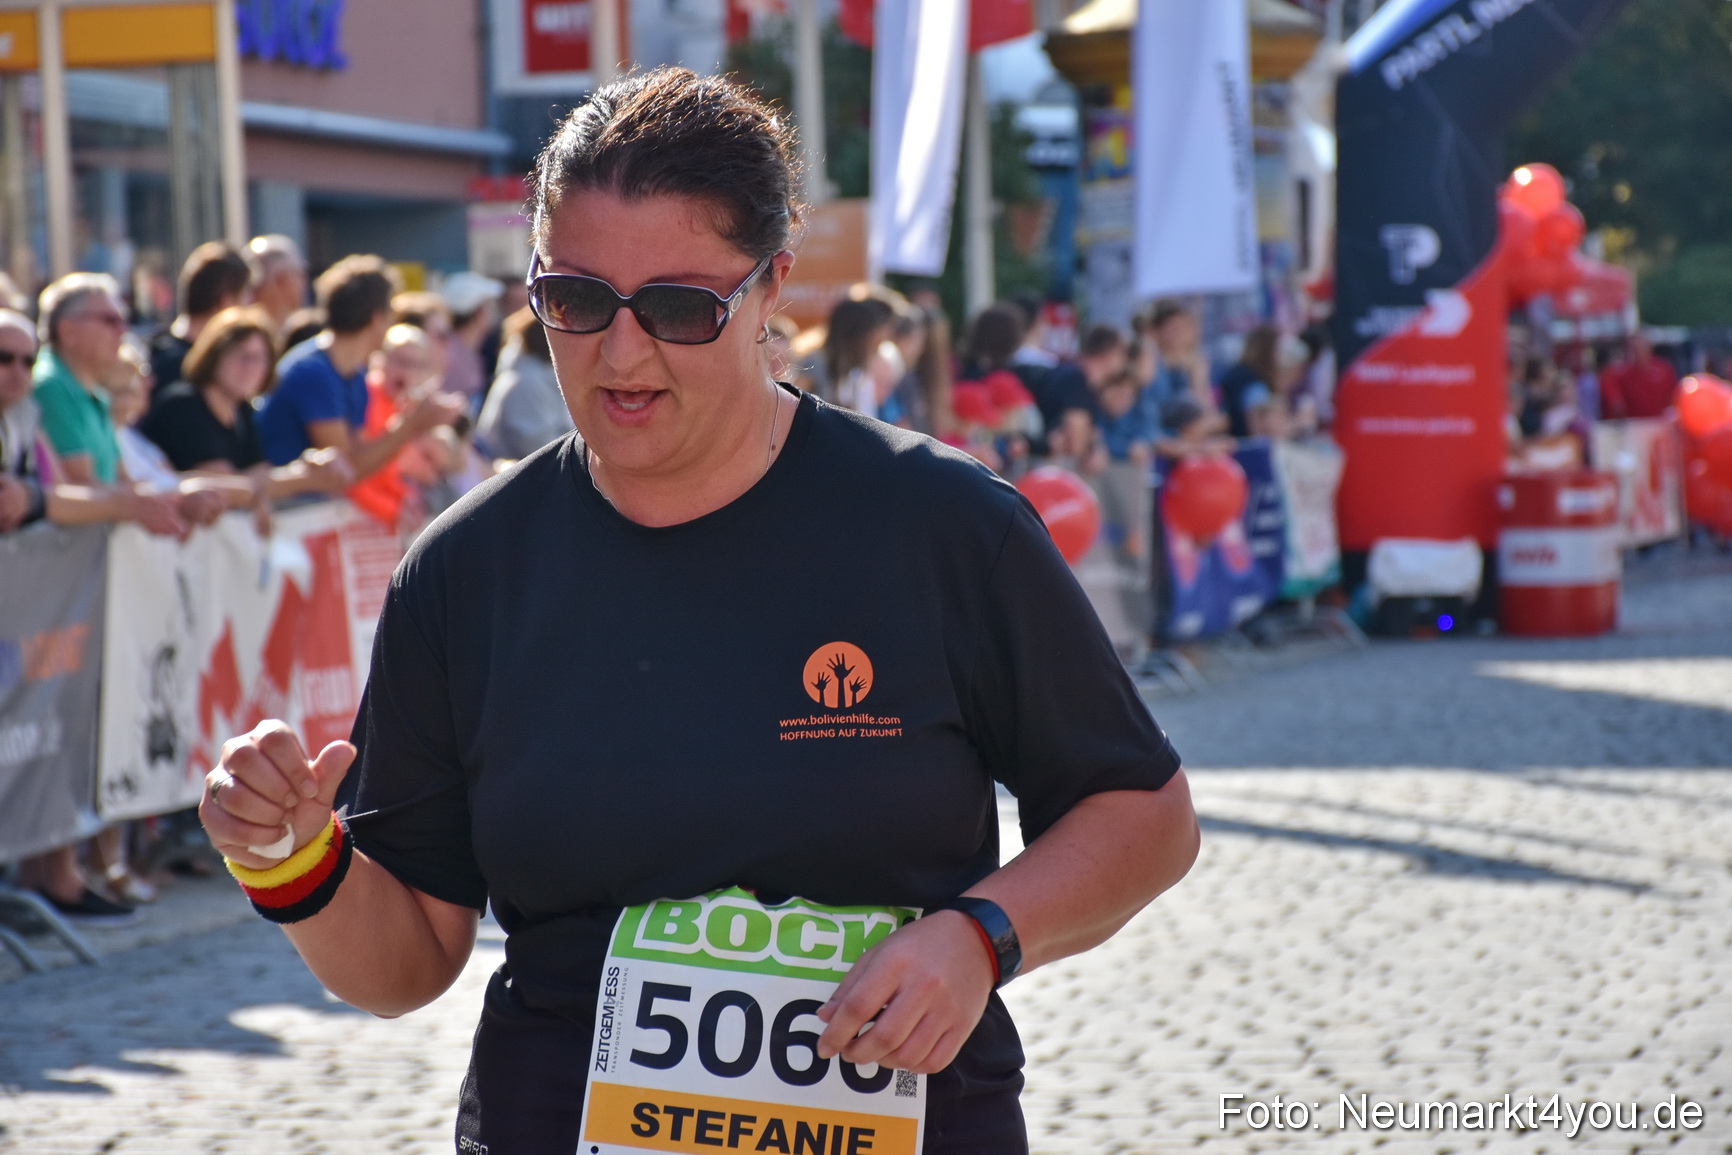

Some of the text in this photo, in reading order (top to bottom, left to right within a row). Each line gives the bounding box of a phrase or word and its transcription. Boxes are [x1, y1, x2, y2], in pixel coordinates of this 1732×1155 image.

[780, 713, 900, 727] www.bolivienhilfe.com
[780, 728, 903, 741] HOFFNUNG AUF ZUKUNFT
[611, 967, 629, 1073] TRANSPONDER ZEITMESSUNG
[630, 1102, 876, 1155] STEFANIE
